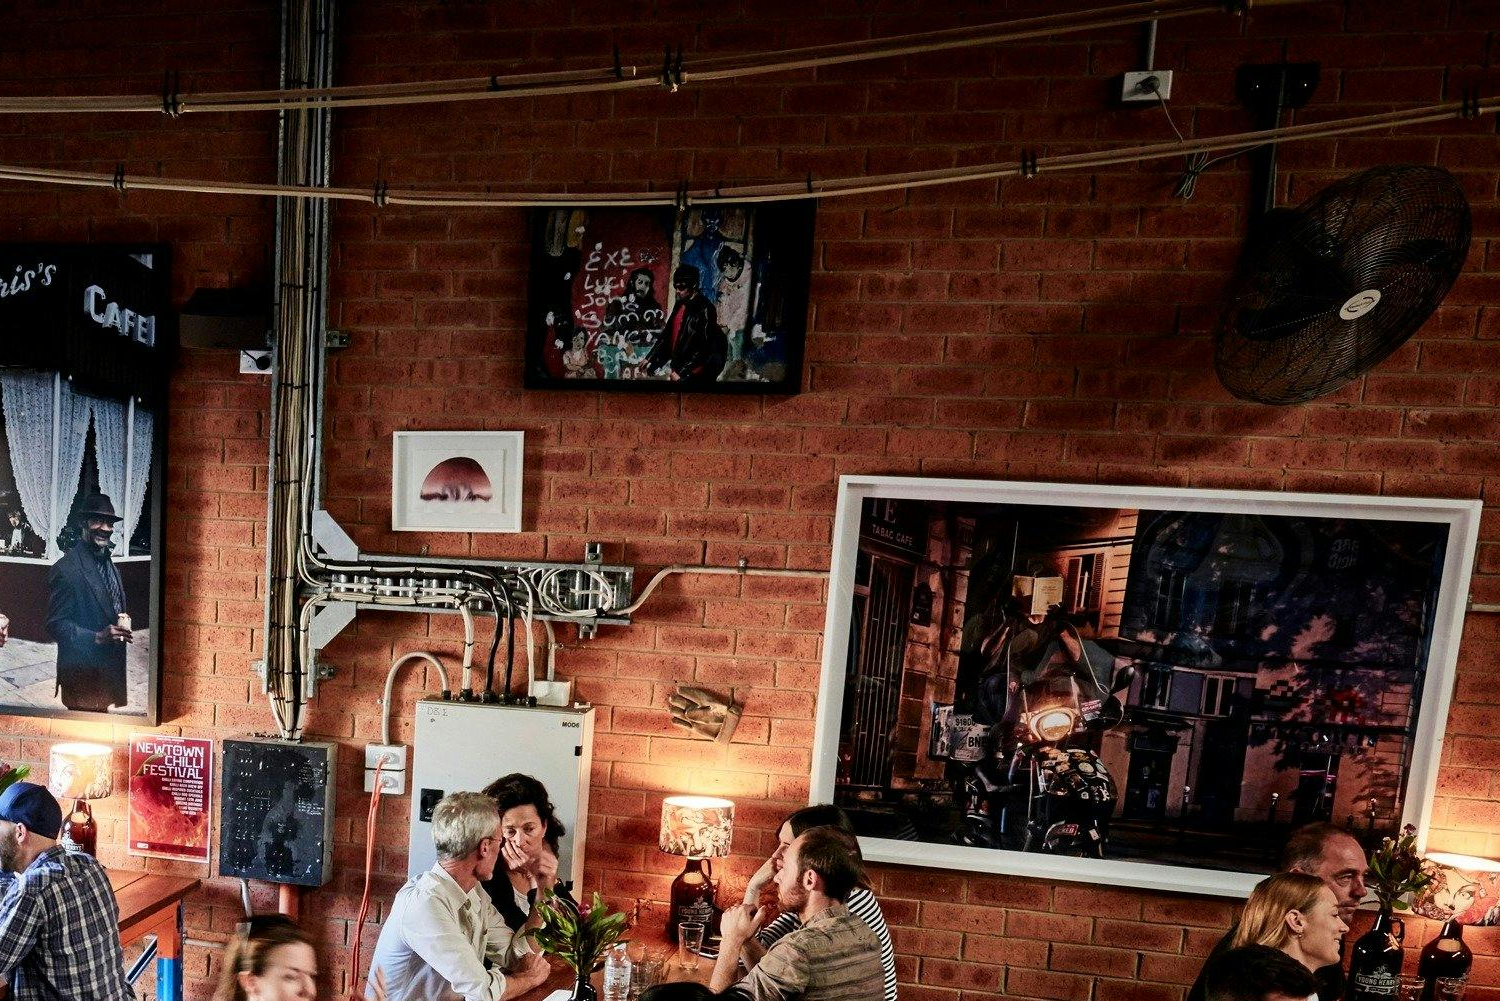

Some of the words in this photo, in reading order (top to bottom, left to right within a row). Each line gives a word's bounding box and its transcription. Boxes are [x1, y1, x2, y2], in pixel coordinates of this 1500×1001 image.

[872, 523, 894, 540] TABAC
[896, 532, 914, 546] CAFE
[136, 742, 204, 758] NEWTOWN
[164, 755, 203, 769] CHILLI
[143, 765, 203, 779] FESTIVAL
